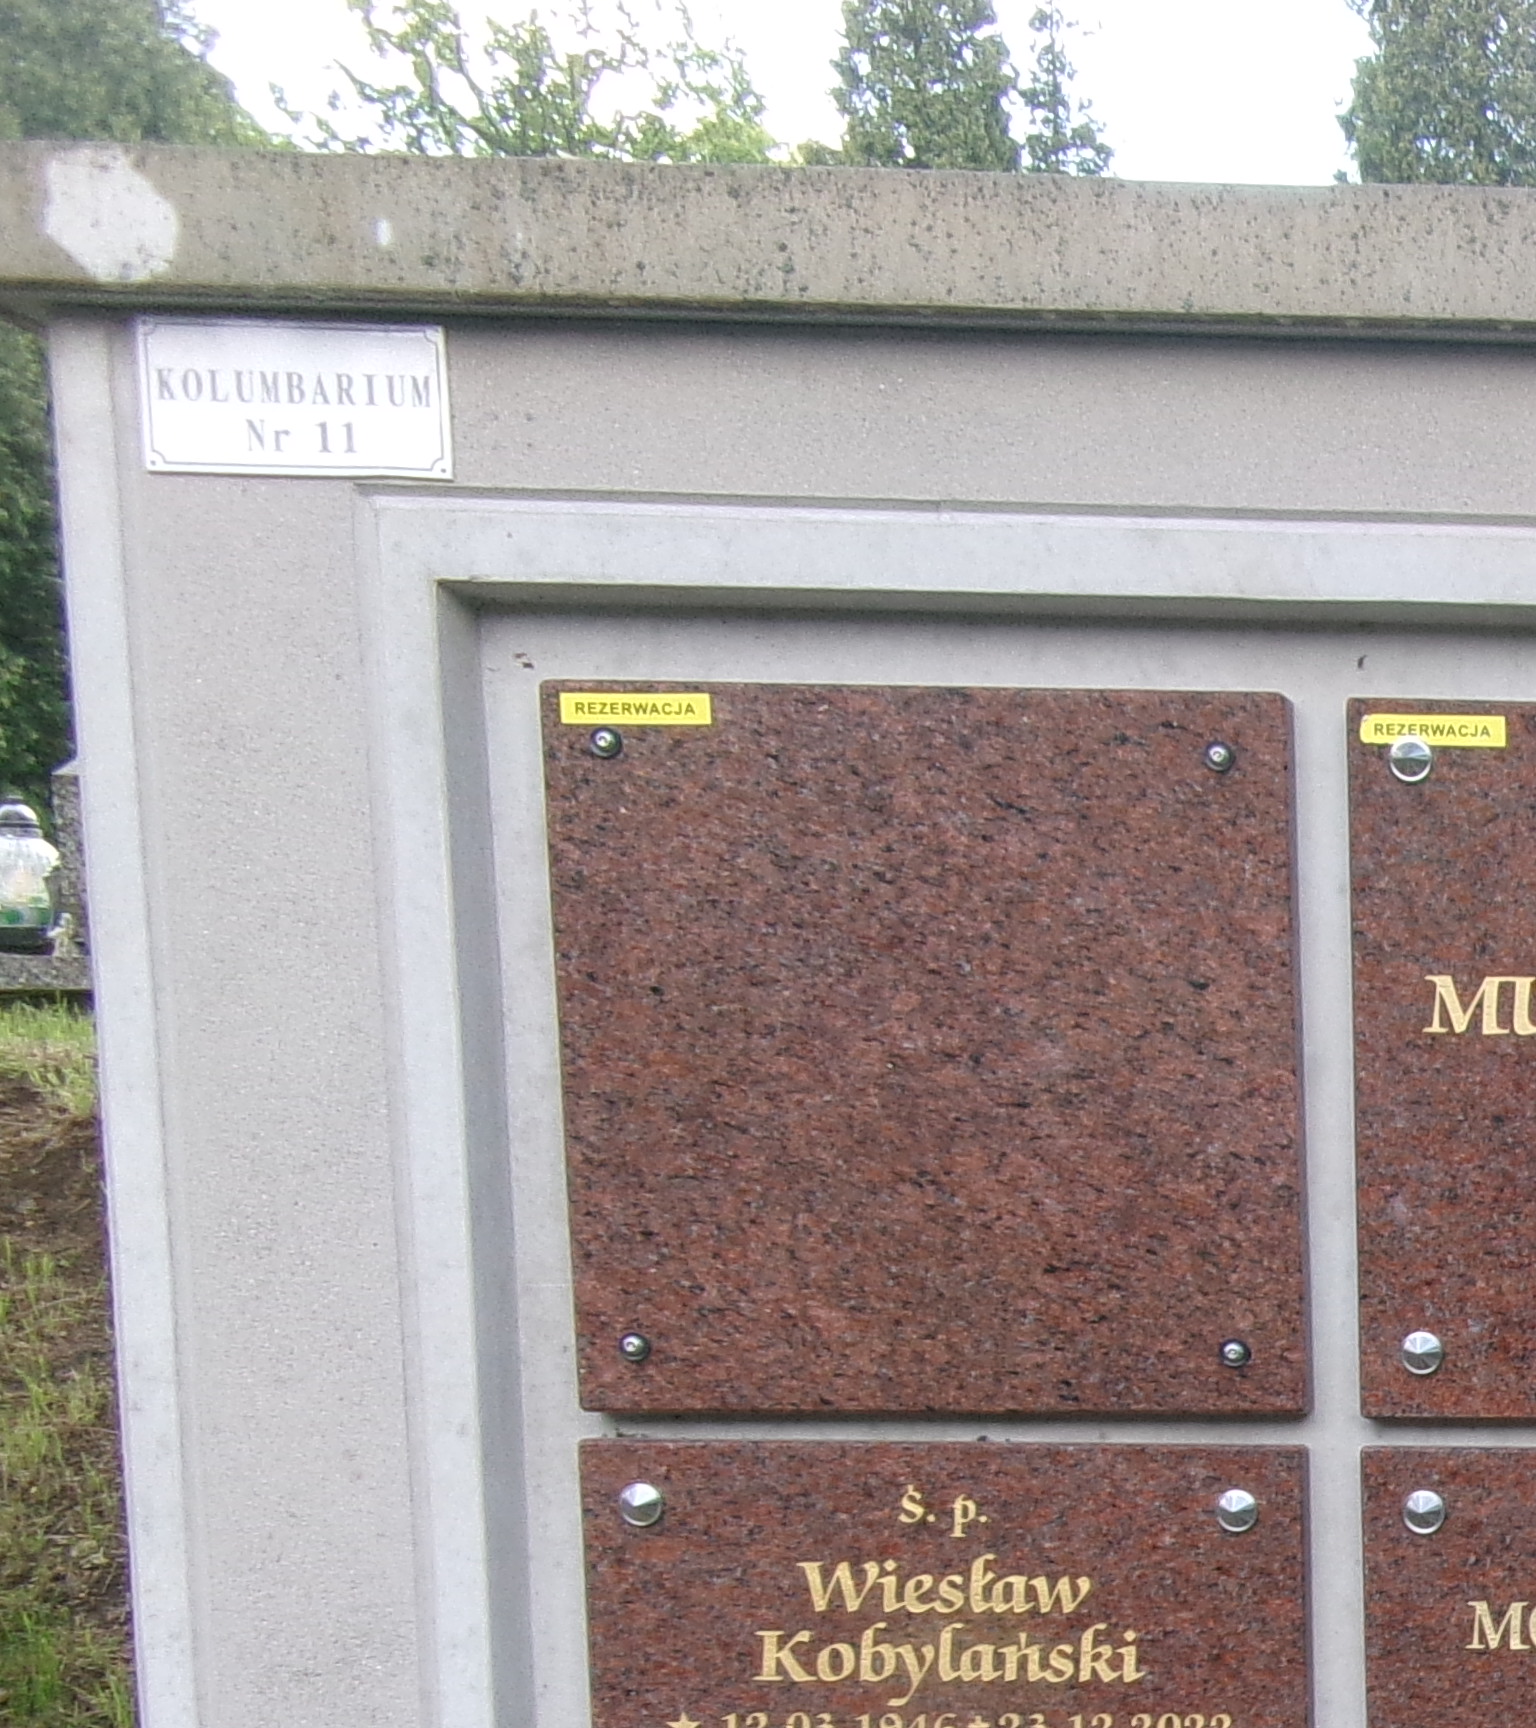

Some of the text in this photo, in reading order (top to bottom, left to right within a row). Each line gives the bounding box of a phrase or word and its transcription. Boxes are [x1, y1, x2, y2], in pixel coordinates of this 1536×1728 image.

[155, 366, 432, 408] KOLUMBARIUM
[245, 418, 358, 454] Nr 11
[573, 701, 697, 716] REZERWACJA
[1373, 722, 1491, 738] REZERWACJA
[795, 1553, 1091, 1614] Wiesław
[752, 1621, 1147, 1707] Kobylański
